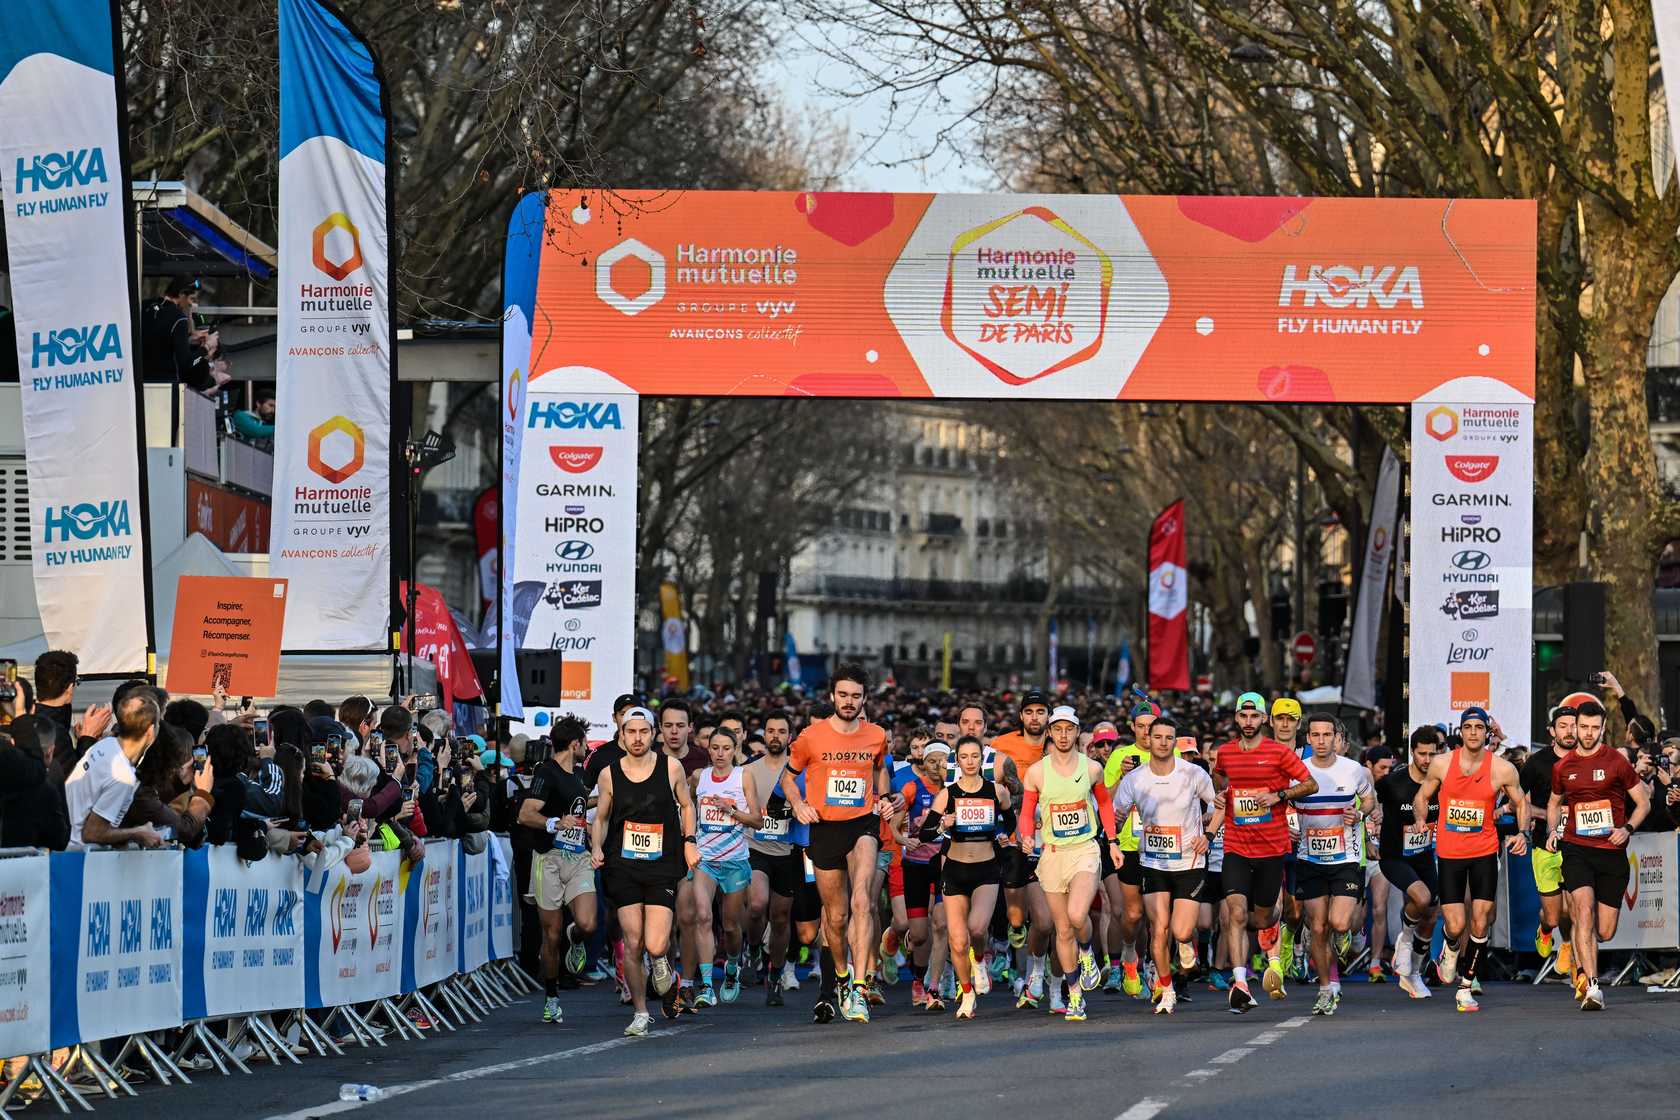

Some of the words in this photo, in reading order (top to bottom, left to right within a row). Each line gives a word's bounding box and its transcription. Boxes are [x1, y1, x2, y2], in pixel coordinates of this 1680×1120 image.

[16, 147, 108, 194] HOKA
[16, 201, 36, 217] FLY
[39, 195, 87, 214] HUMAN
[88, 192, 108, 208] FLY
[677, 243, 797, 264] Harmonie
[977, 247, 1076, 265] Harmonie
[677, 264, 797, 284] mutuelle
[977, 264, 1075, 280] mutuelle
[301, 283, 373, 298] Harmonie
[1278, 264, 1425, 308] HOKA
[301, 297, 373, 312] mutuelle
[676, 302, 748, 313] GROUPE
[300, 325, 348, 333] GROUPE
[977, 323, 1010, 343] DE
[1278, 318, 1309, 333] FLY
[1313, 319, 1388, 334] HUMAN
[1391, 319, 1423, 335] FLY
[669, 328, 744, 341] AVANÇONS
[31, 323, 122, 369] HOKA
[288, 347, 345, 357] AVANÇONS
[33, 376, 52, 392] FLY
[55, 369, 103, 389] HUMAN
[105, 368, 124, 384] FLY
[528, 401, 622, 430] HOKA
[1463, 408, 1520, 418] Harmonie
[1463, 417, 1520, 428] mutuelle
[558, 451, 594, 461] Colgate
[1454, 461, 1490, 470] Colgate
[295, 485, 371, 500] Harmonie
[294, 500, 371, 514] mutuelle
[44, 499, 131, 543] HOKA
[545, 517, 604, 534] HiPRO
[293, 527, 342, 536] GROUPE
[1441, 527, 1501, 543] HiPRO
[46, 551, 67, 566] FLY
[70, 546, 117, 564] HUMAN
[117, 545, 132, 560] FLY
[281, 549, 338, 560] AVANÇONS
[546, 563, 602, 573] HYUNDAI
[1443, 573, 1499, 583] HYUNDAI
[570, 582, 590, 596] Ker
[1467, 592, 1488, 605] Ker
[1446, 642, 1494, 665] Lenor
[561, 689, 588, 699] range
[822, 752, 857, 761] 21.097
[858, 752, 873, 761] KM
[834, 780, 857, 793] 1042
[705, 809, 725, 821] 8212
[961, 808, 985, 820] 8098
[1057, 813, 1080, 826] 1029
[1449, 809, 1478, 821] 30454
[1581, 812, 1603, 825] 11401
[762, 818, 779, 830] 015
[631, 833, 651, 847] 1016
[1148, 835, 1174, 848] 63786
[1311, 838, 1337, 850] 63747
[88, 901, 111, 957] HOKA
[119, 899, 142, 954] HOKA
[150, 897, 172, 951] HOKA
